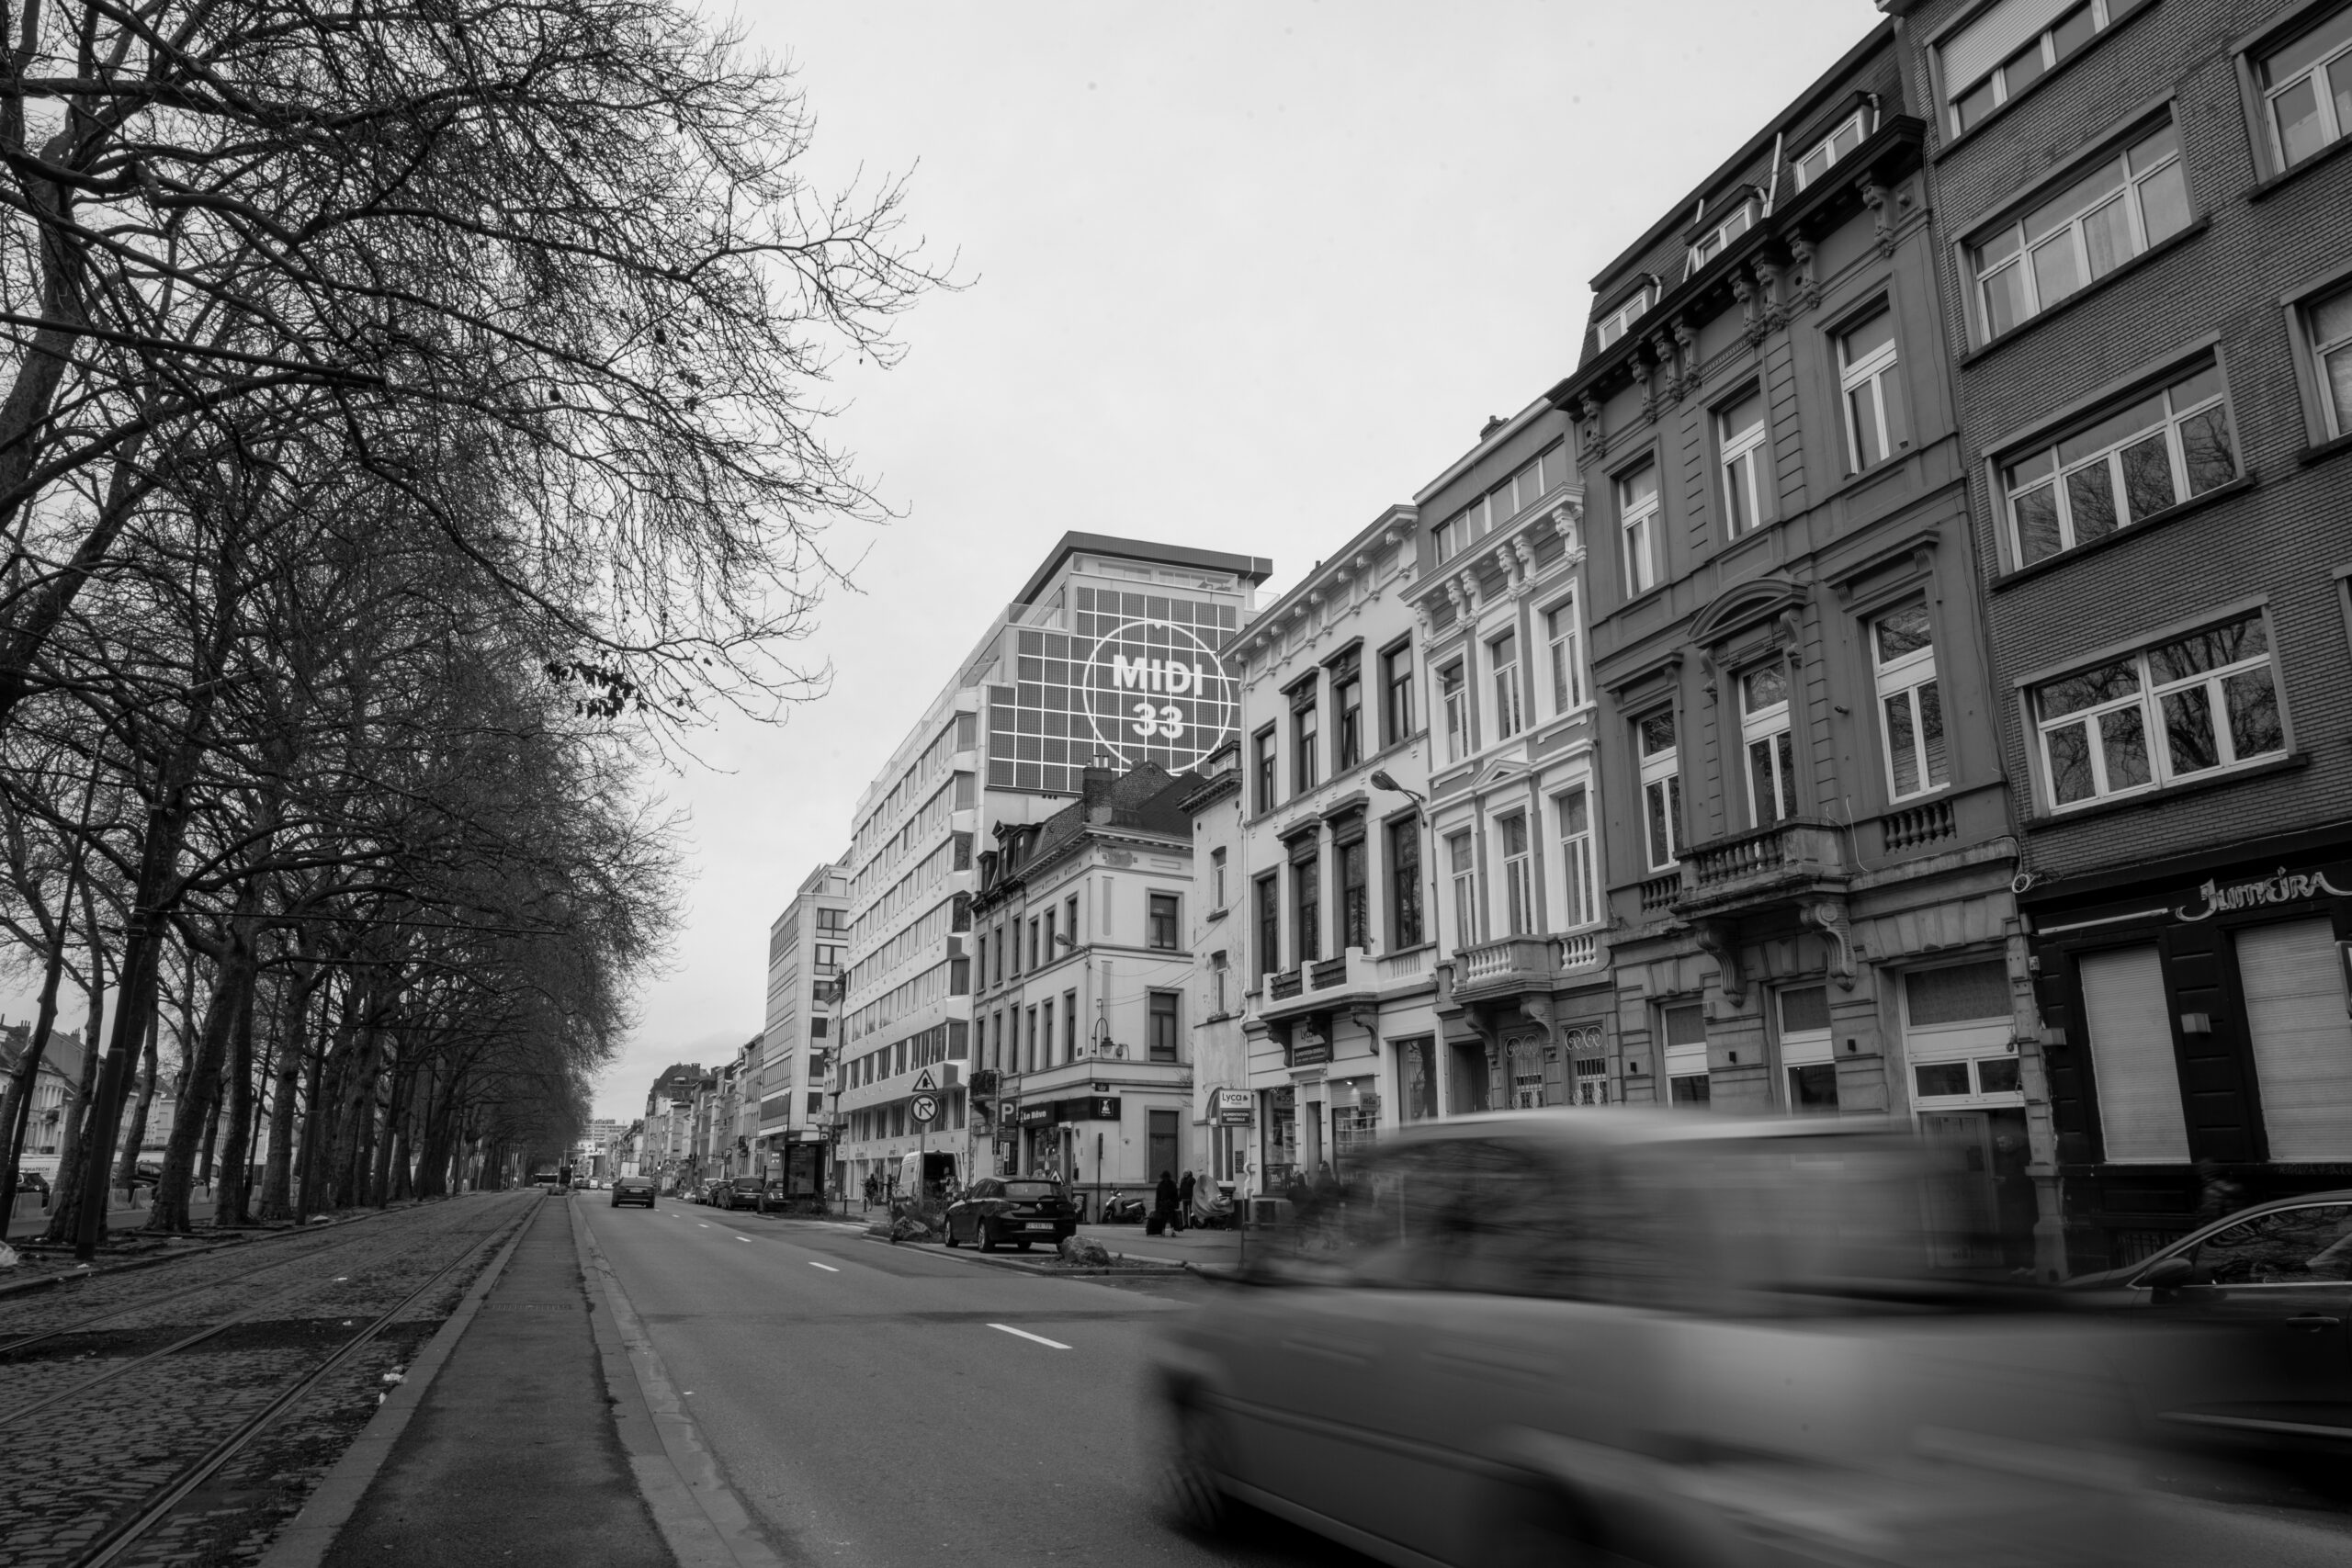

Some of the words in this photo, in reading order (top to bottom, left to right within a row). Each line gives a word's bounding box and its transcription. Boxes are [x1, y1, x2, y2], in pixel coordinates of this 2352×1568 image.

[1113, 654, 1204, 696] MIDI
[1131, 702, 1184, 739] 33
[1222, 1092, 1242, 1103] Lyca
[1001, 1103, 1014, 1122] P
